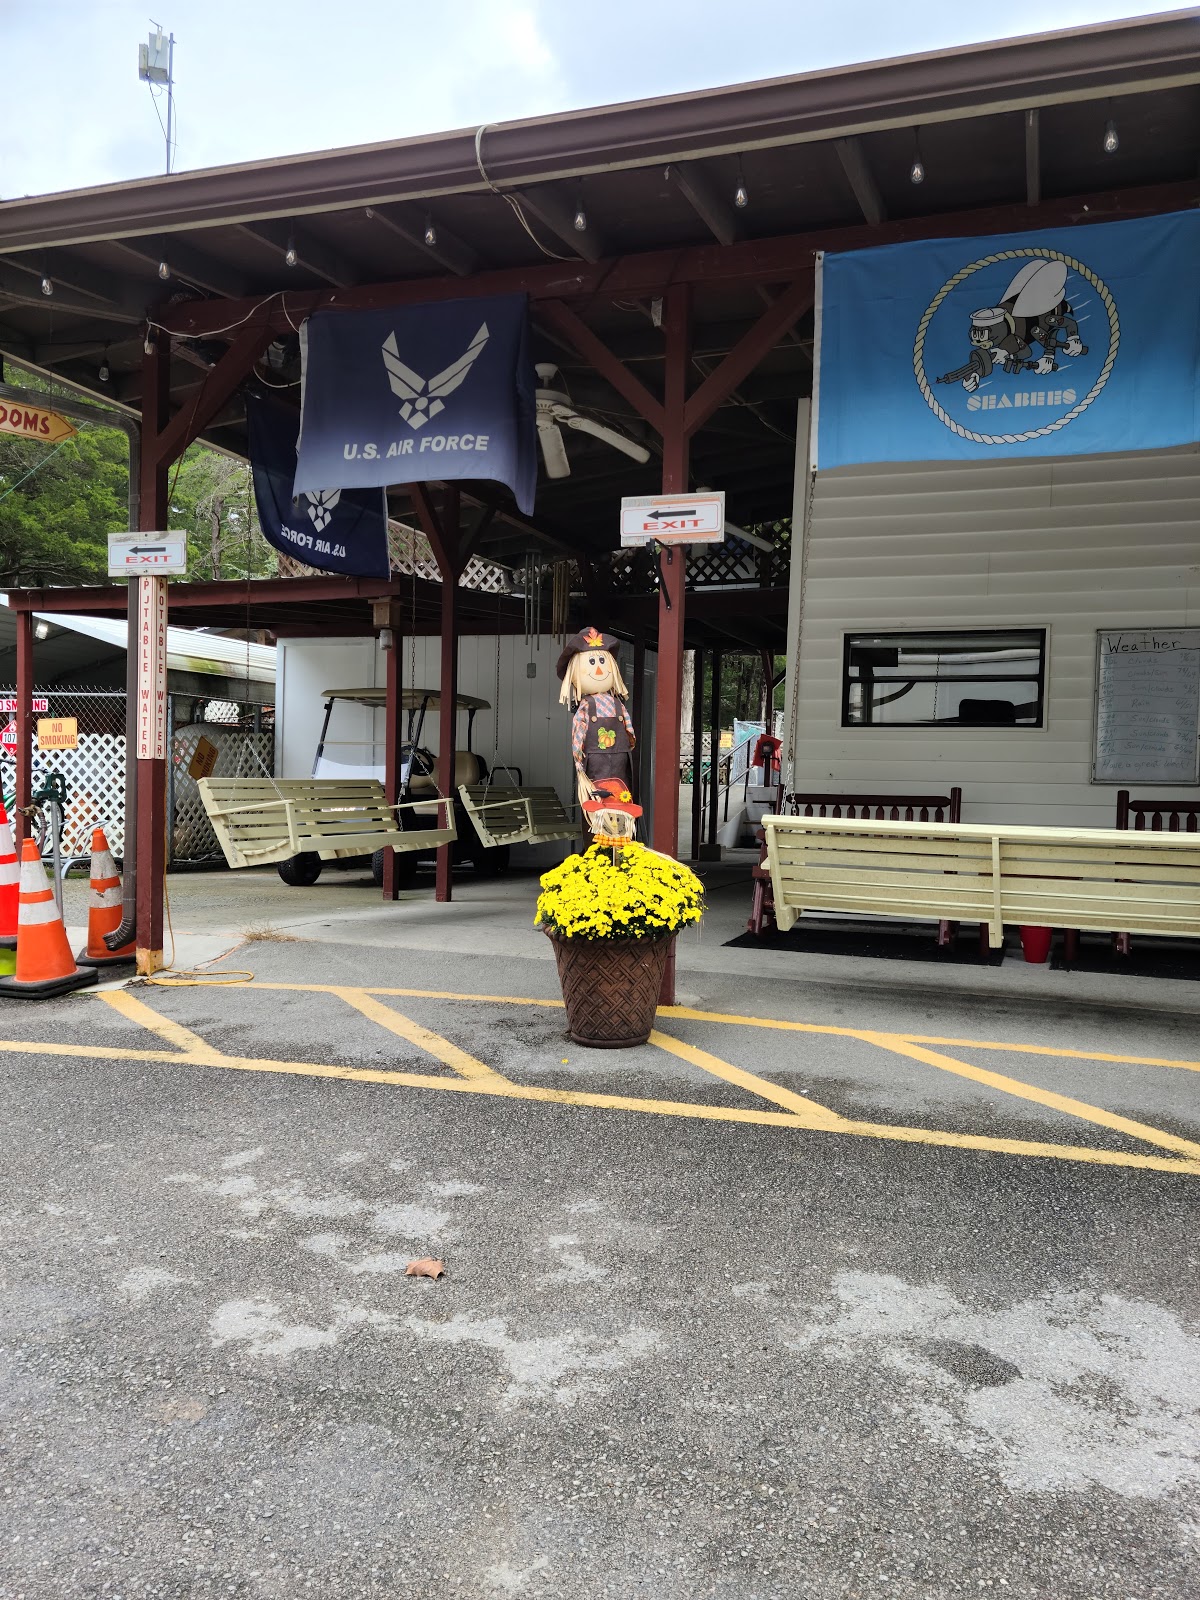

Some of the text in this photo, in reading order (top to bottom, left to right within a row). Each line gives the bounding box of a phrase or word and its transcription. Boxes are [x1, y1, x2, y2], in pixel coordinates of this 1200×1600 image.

[966, 388, 1077, 412] SEABEES
[343, 433, 490, 460] U.S. AIR FORCE
[642, 518, 705, 531] EXIT
[125, 554, 173, 564] EXIT
[1107, 636, 1181, 654] Weather
[52, 722, 63, 733] NO
[141, 689, 150, 754] WATER
[3, 733, 17, 743] 107
[40, 734, 76, 746] SMOKING
[201, 746, 216, 777] MOKING
